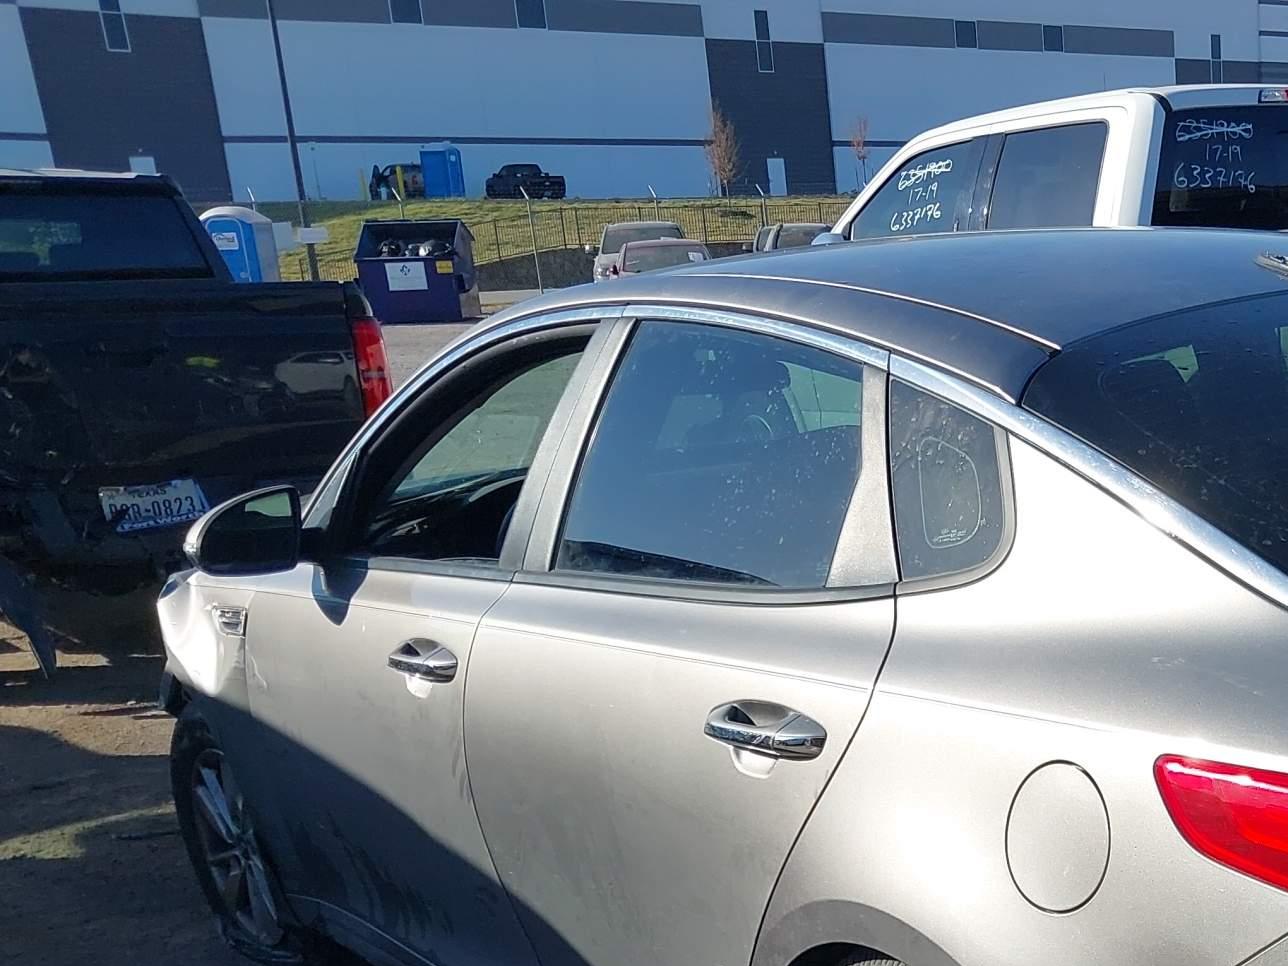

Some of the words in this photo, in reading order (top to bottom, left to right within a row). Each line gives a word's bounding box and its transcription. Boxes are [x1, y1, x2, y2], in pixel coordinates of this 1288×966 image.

[1206, 143, 1242, 162] 17-19
[1174, 162, 1256, 193] 6337176
[908, 182, 938, 206] 17-19
[891, 203, 941, 231] 6337176
